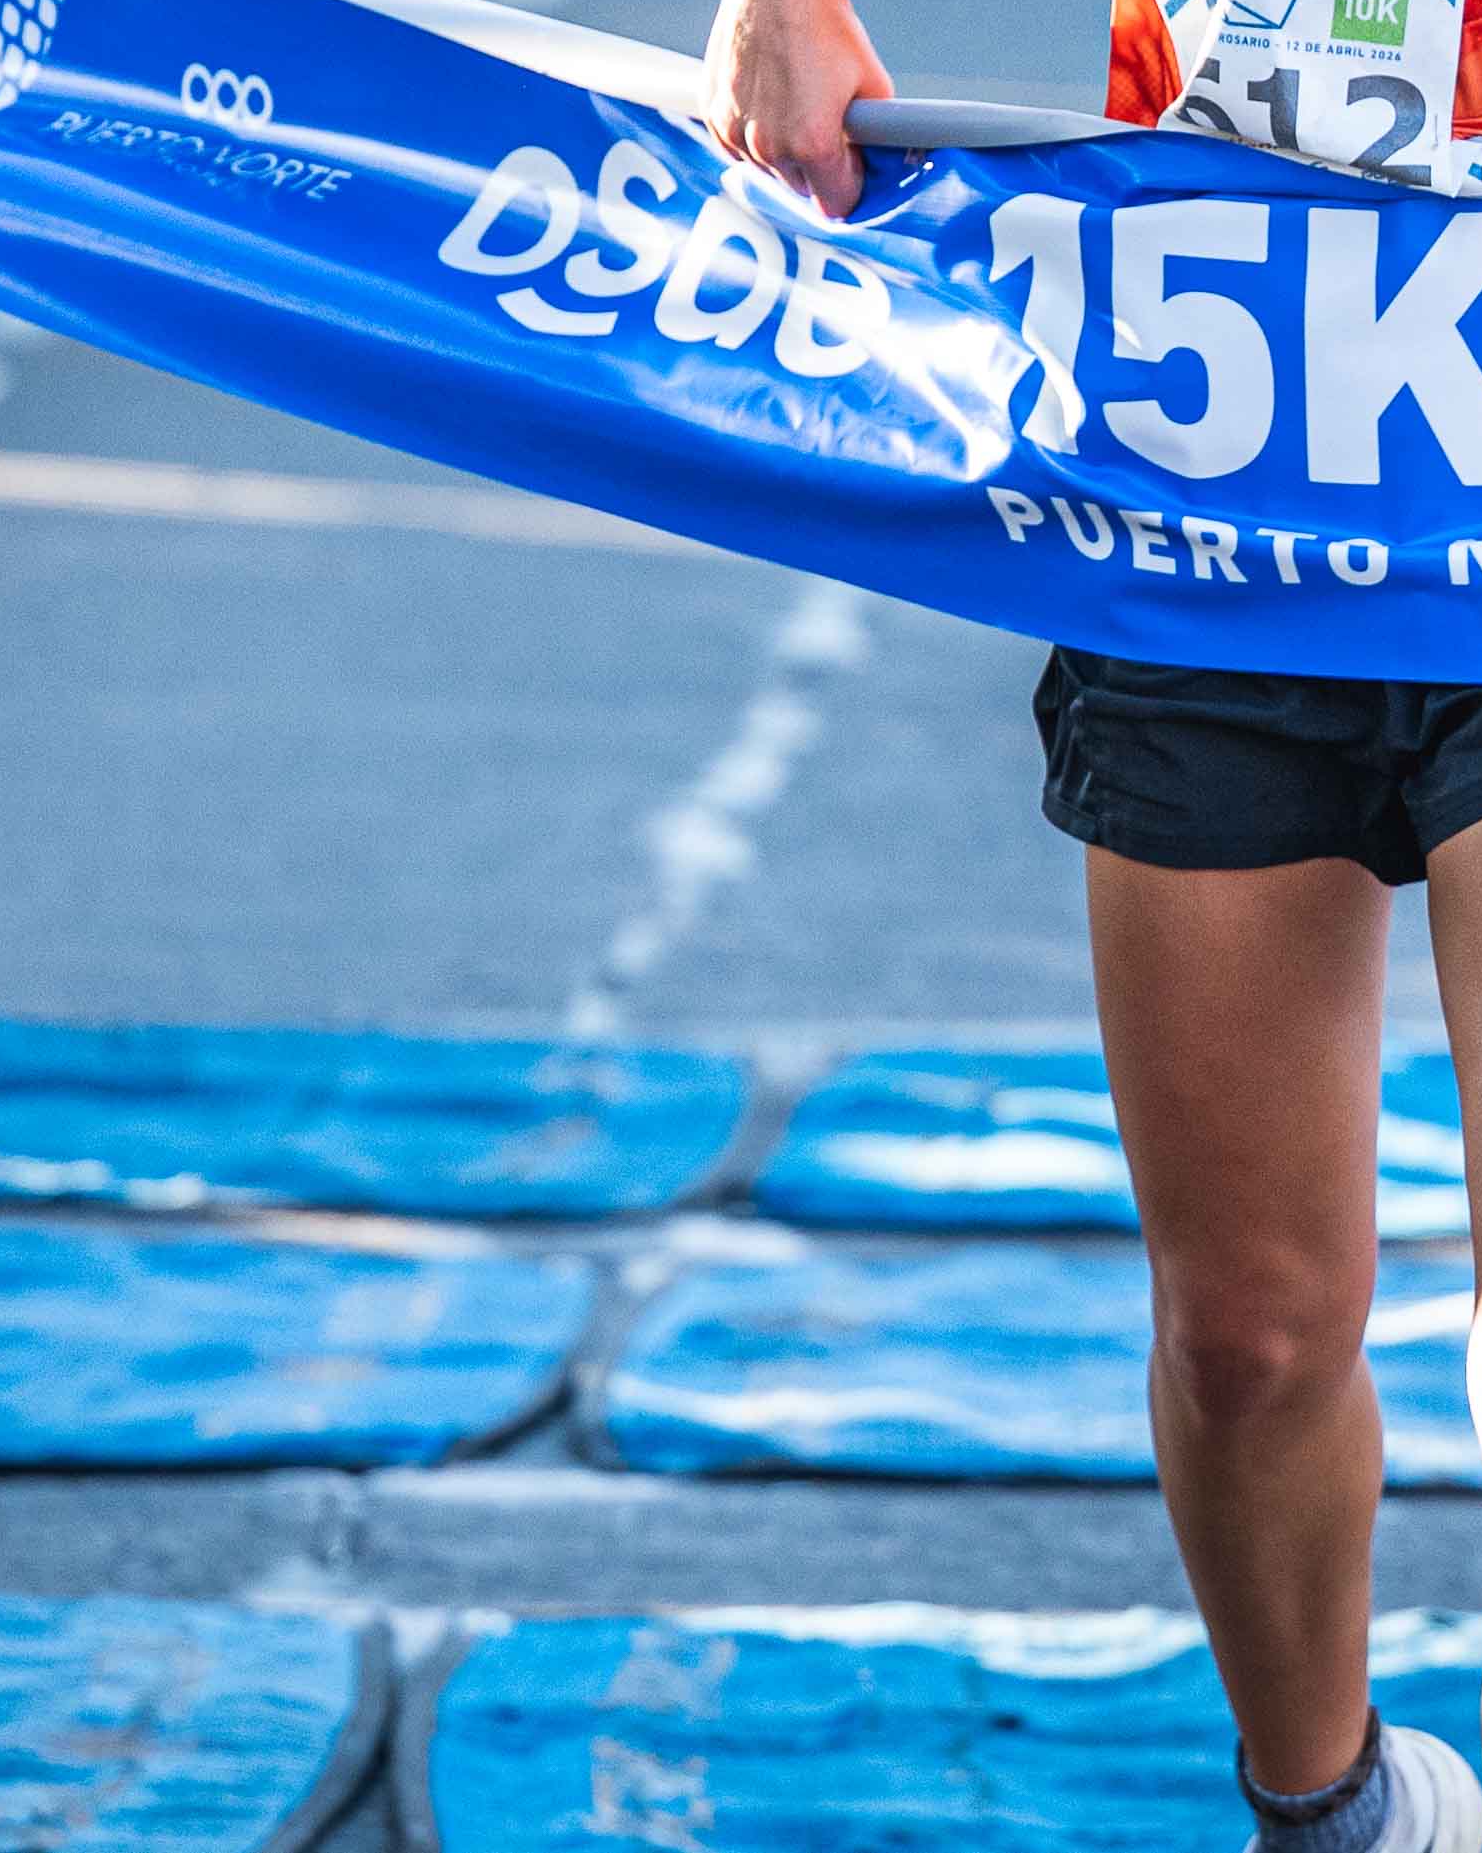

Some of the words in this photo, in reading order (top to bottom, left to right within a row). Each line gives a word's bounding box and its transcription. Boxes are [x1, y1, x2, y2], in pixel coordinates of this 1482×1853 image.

[1217, 31, 1271, 50] ROSARIO
[1307, 41, 1322, 54] DE
[1326, 43, 1365, 58] ABRIL
[985, 484, 1390, 587] PUERTO
